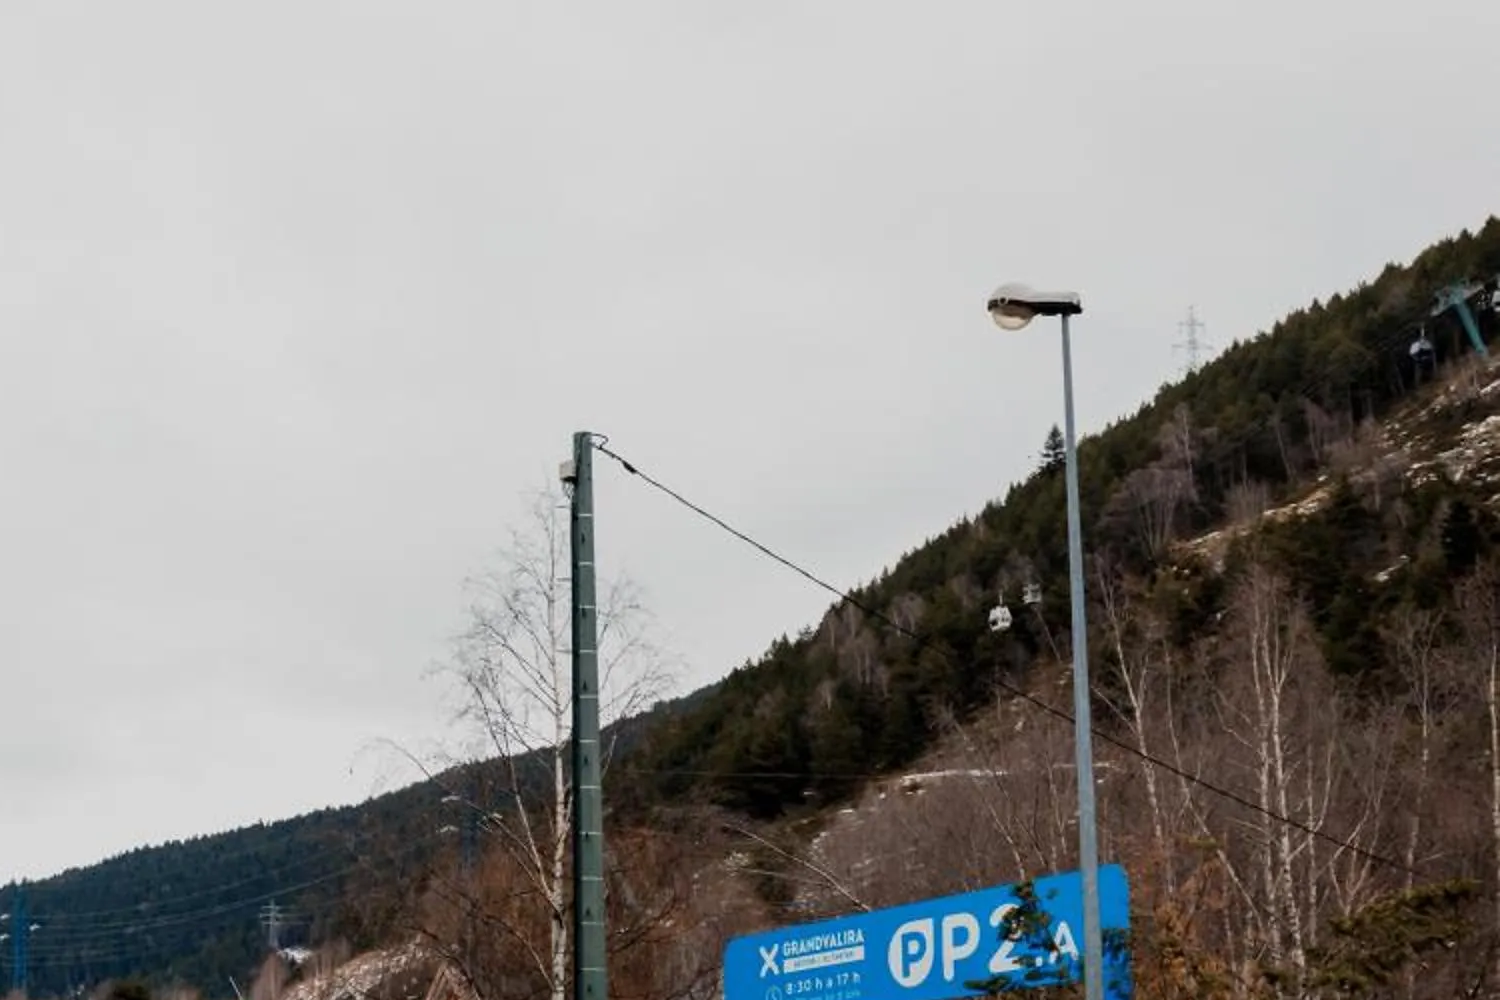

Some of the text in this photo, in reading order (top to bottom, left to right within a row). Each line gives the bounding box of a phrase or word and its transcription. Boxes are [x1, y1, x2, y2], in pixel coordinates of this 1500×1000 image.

[782, 927, 865, 957] GRANDVALIRA
[815, 976, 823, 990] h
[836, 971, 849, 985] 17
